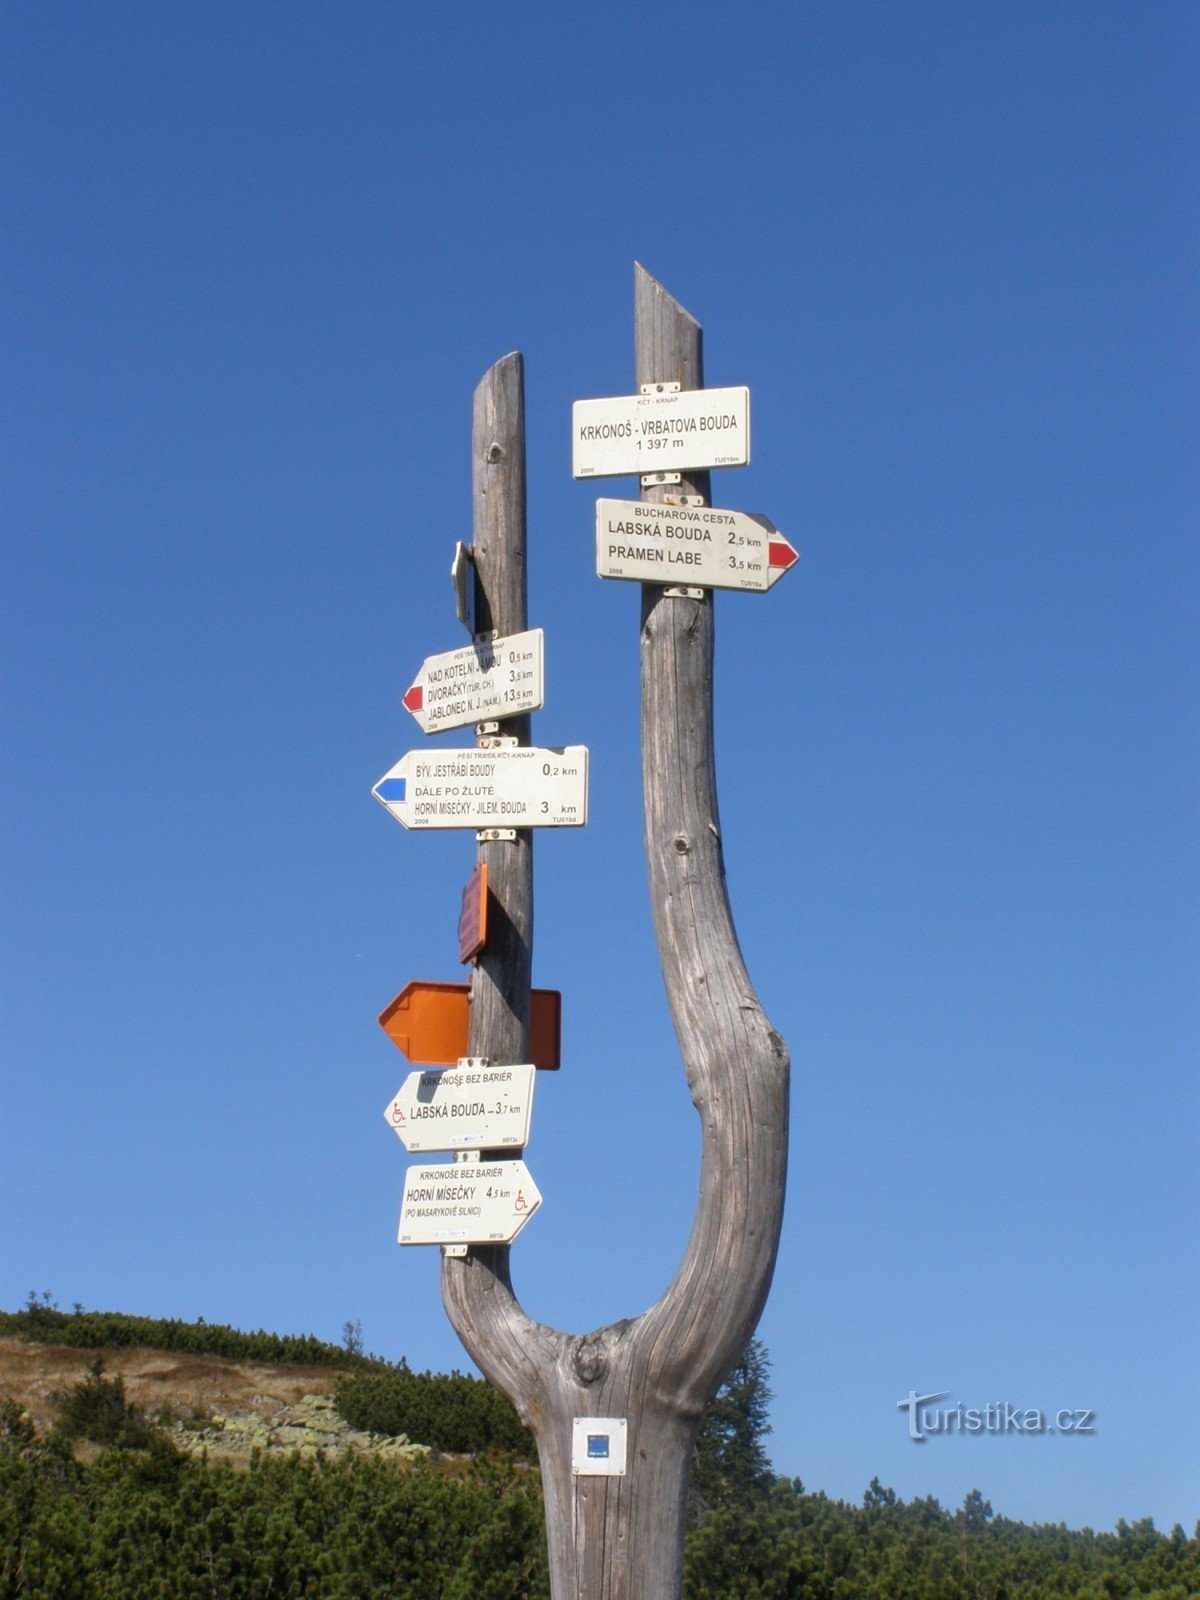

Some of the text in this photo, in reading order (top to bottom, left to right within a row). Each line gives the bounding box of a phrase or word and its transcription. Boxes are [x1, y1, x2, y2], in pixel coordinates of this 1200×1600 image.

[638, 398, 650, 406] KČT
[580, 420, 632, 441] KRKONOŠ
[641, 418, 696, 436] VRBATOVA
[700, 414, 738, 431] BOUDA
[636, 438, 684, 450] 1 397 m
[635, 507, 736, 525] BUCHAROVA CESTA
[608, 521, 761, 547] LABSKÁ BOUDA 2,5 km
[608, 546, 761, 571] PRAMEN LABE 3,5 km
[428, 670, 442, 683] NAD
[445, 660, 475, 678] KOTELNÍ
[509, 651, 521, 664] 0,5
[428, 681, 467, 702] DVORAČKY
[510, 670, 521, 682] 3,5
[428, 701, 466, 721] JABLONEC
[468, 699, 475, 710] N.
[476, 698, 482, 709] J.
[504, 689, 521, 702] 13,5
[522, 690, 533, 698] km
[416, 763, 432, 777] BÝV.
[469, 764, 495, 777] BOUDY
[542, 763, 558, 777] 0,2
[562, 768, 577, 776] km
[415, 785, 494, 796] DÁLE PO ŽLUTÉ
[415, 800, 437, 815] HORNÍ
[501, 802, 527, 814] BOUDA
[541, 802, 549, 813] 3
[561, 805, 576, 813] km
[422, 1072, 512, 1086] KRKONOŠE BEZ BARIÉR
[410, 1102, 520, 1119] LABSKÁ BOUDA 3,7 km
[420, 1168, 503, 1180] KRKONOŠE BEZ BARIÉR
[406, 1186, 436, 1202] HORNÍ
[436, 1184, 476, 1200] MÍSEČKY
[486, 1186, 498, 1199] 4,5
[405, 1209, 416, 1219] (PO
[458, 1206, 481, 1217] SILNICI)
